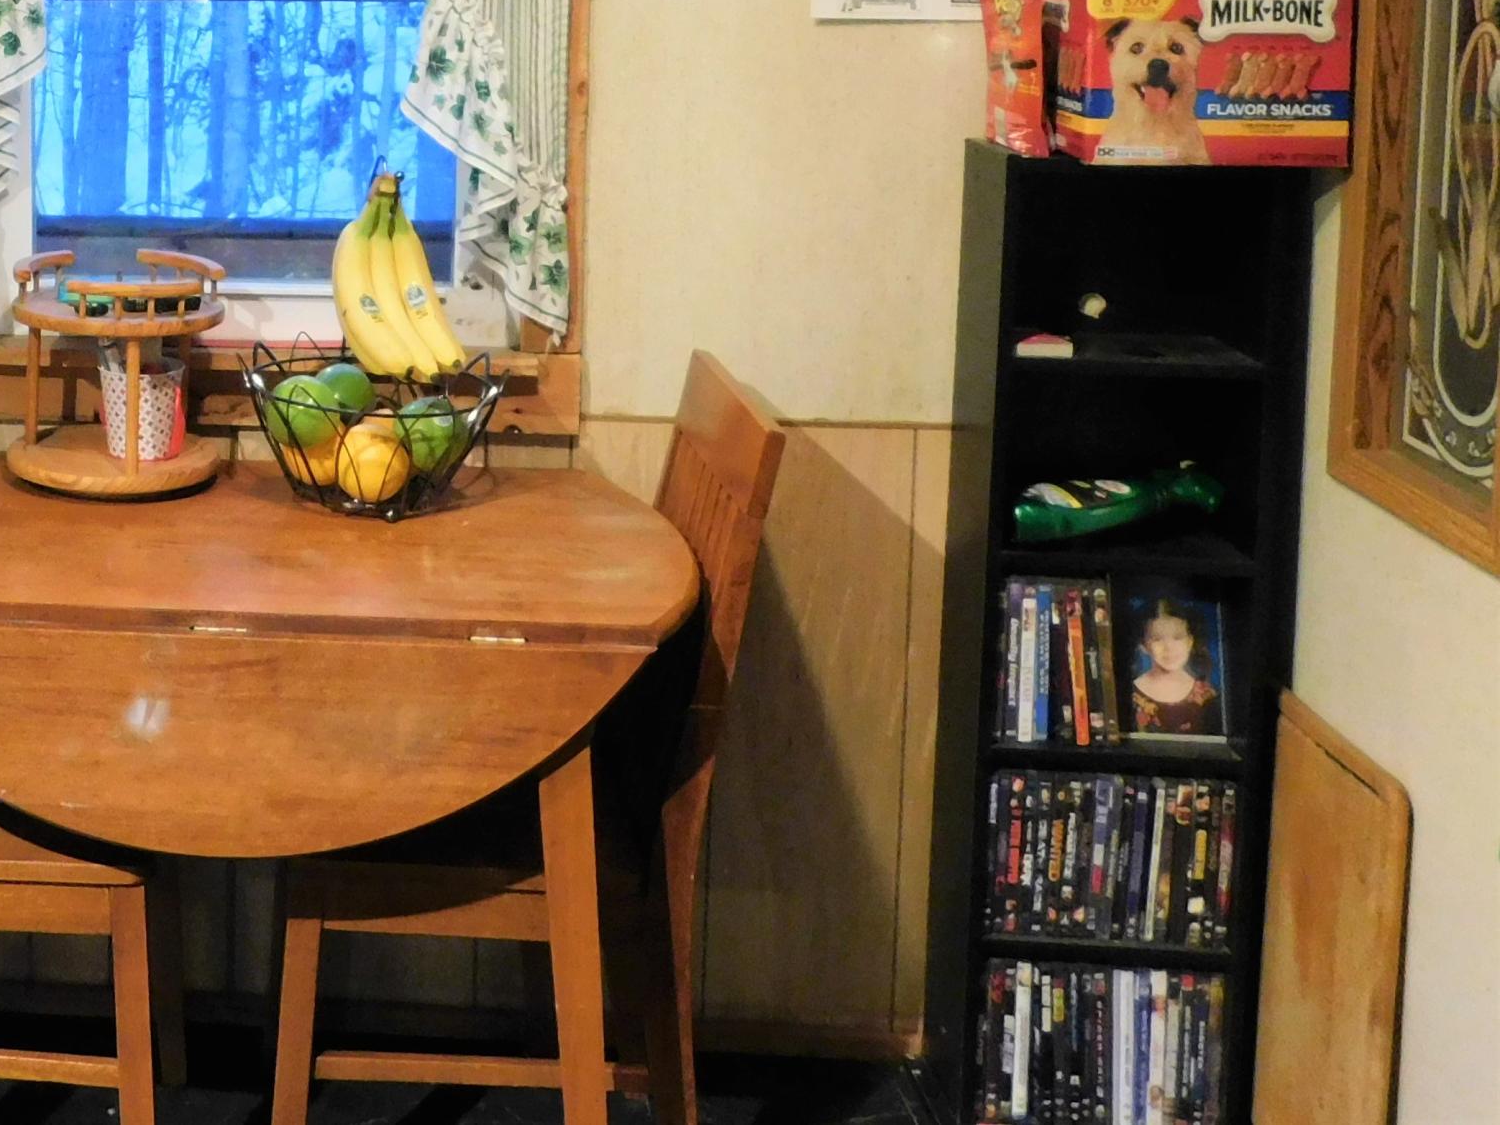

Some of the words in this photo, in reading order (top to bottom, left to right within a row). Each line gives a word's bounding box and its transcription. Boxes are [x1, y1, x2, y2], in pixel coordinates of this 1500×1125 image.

[1207, 103, 1267, 116] FLAVOR
[1270, 103, 1332, 116] SNACKS
[1048, 818, 1065, 882] WANTED
